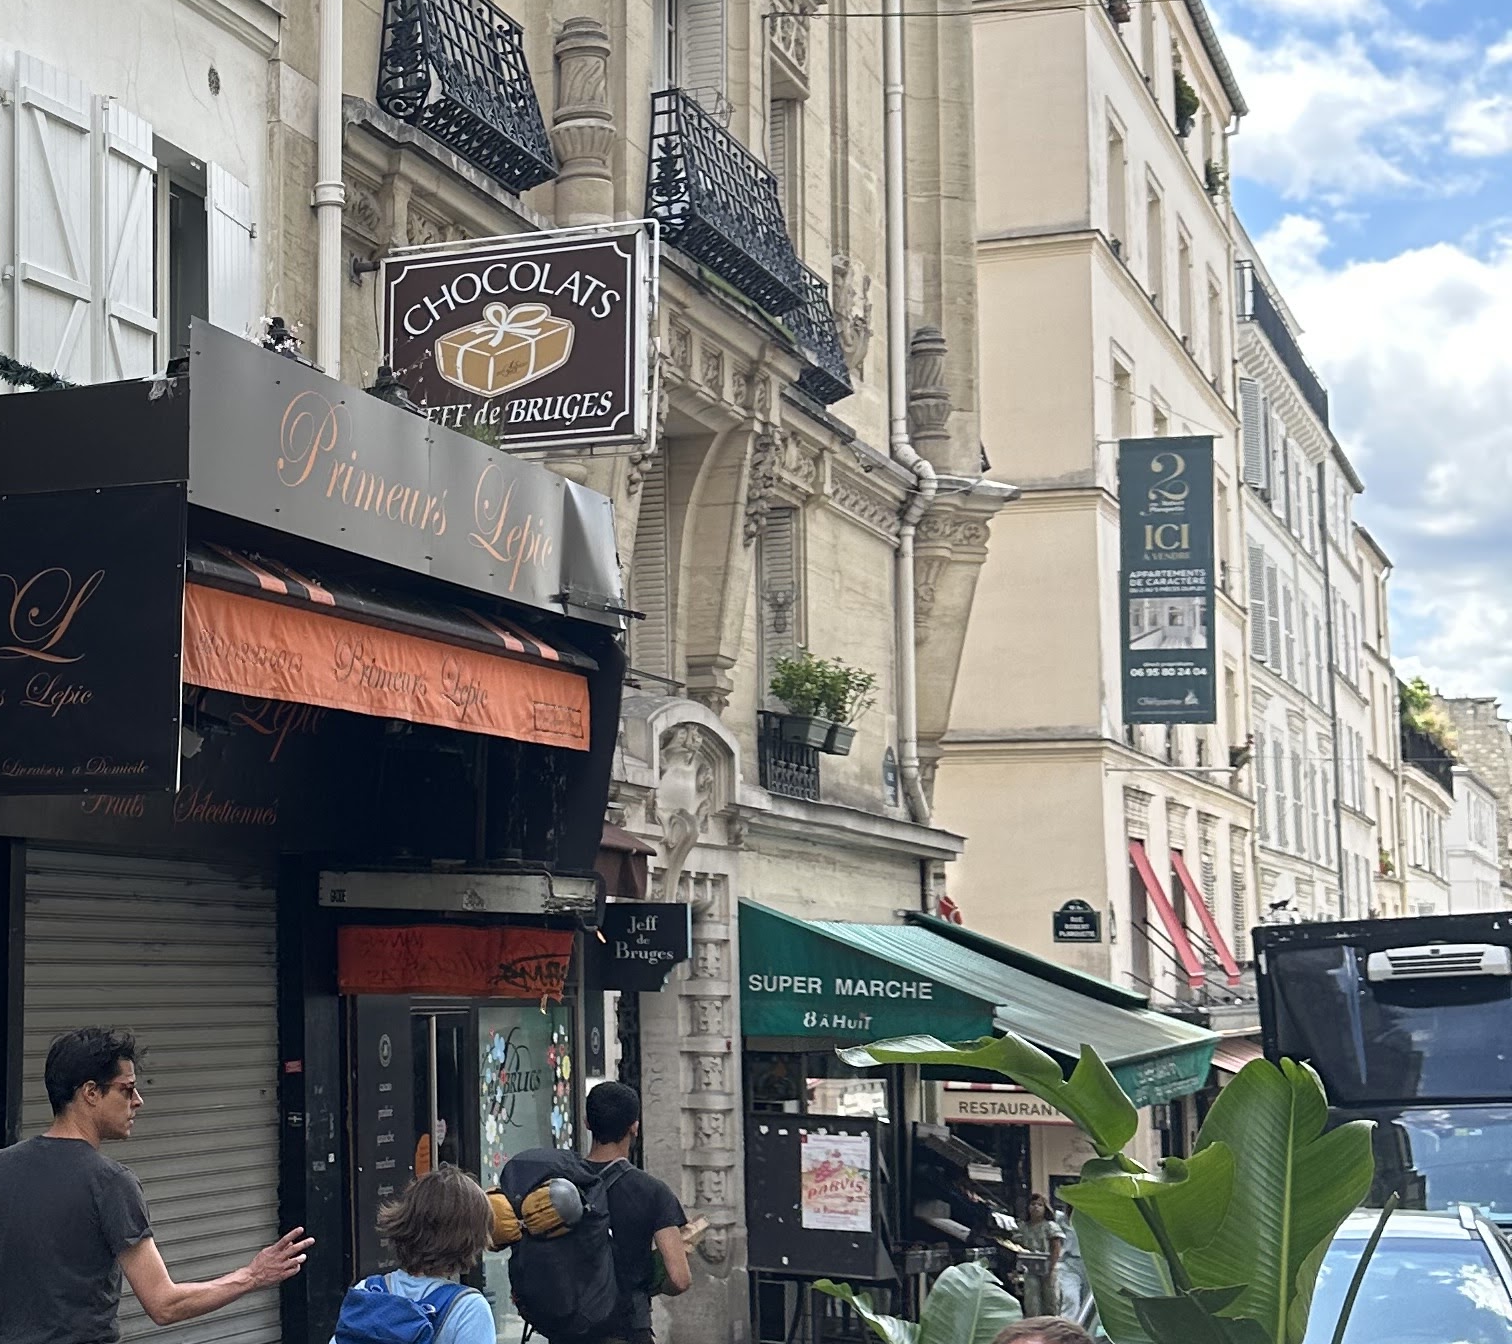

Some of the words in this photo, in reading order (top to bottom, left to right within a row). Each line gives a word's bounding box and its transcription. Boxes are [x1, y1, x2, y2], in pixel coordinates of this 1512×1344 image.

[403, 261, 620, 336] CHOCOLATS
[474, 399, 501, 426] de
[505, 390, 613, 426] BRUGES
[1148, 453, 1189, 501] 2
[277, 390, 448, 538] Primeurs
[468, 463, 553, 593] Lepic
[1144, 524, 1190, 550] ICI
[1129, 569, 1206, 578] APPARTEMENTS
[333, 634, 428, 697] Primeurs
[441, 653, 489, 721] Lepic
[19, 672, 94, 716] Lepic
[84, 757, 149, 776] Domicile
[627, 915, 658, 933] Jeff
[636, 934, 650, 944] de
[615, 941, 674, 964] Bruges
[749, 975, 822, 995] SUPER
[835, 978, 933, 1000] MARCHE
[803, 1011, 817, 1027] 8
